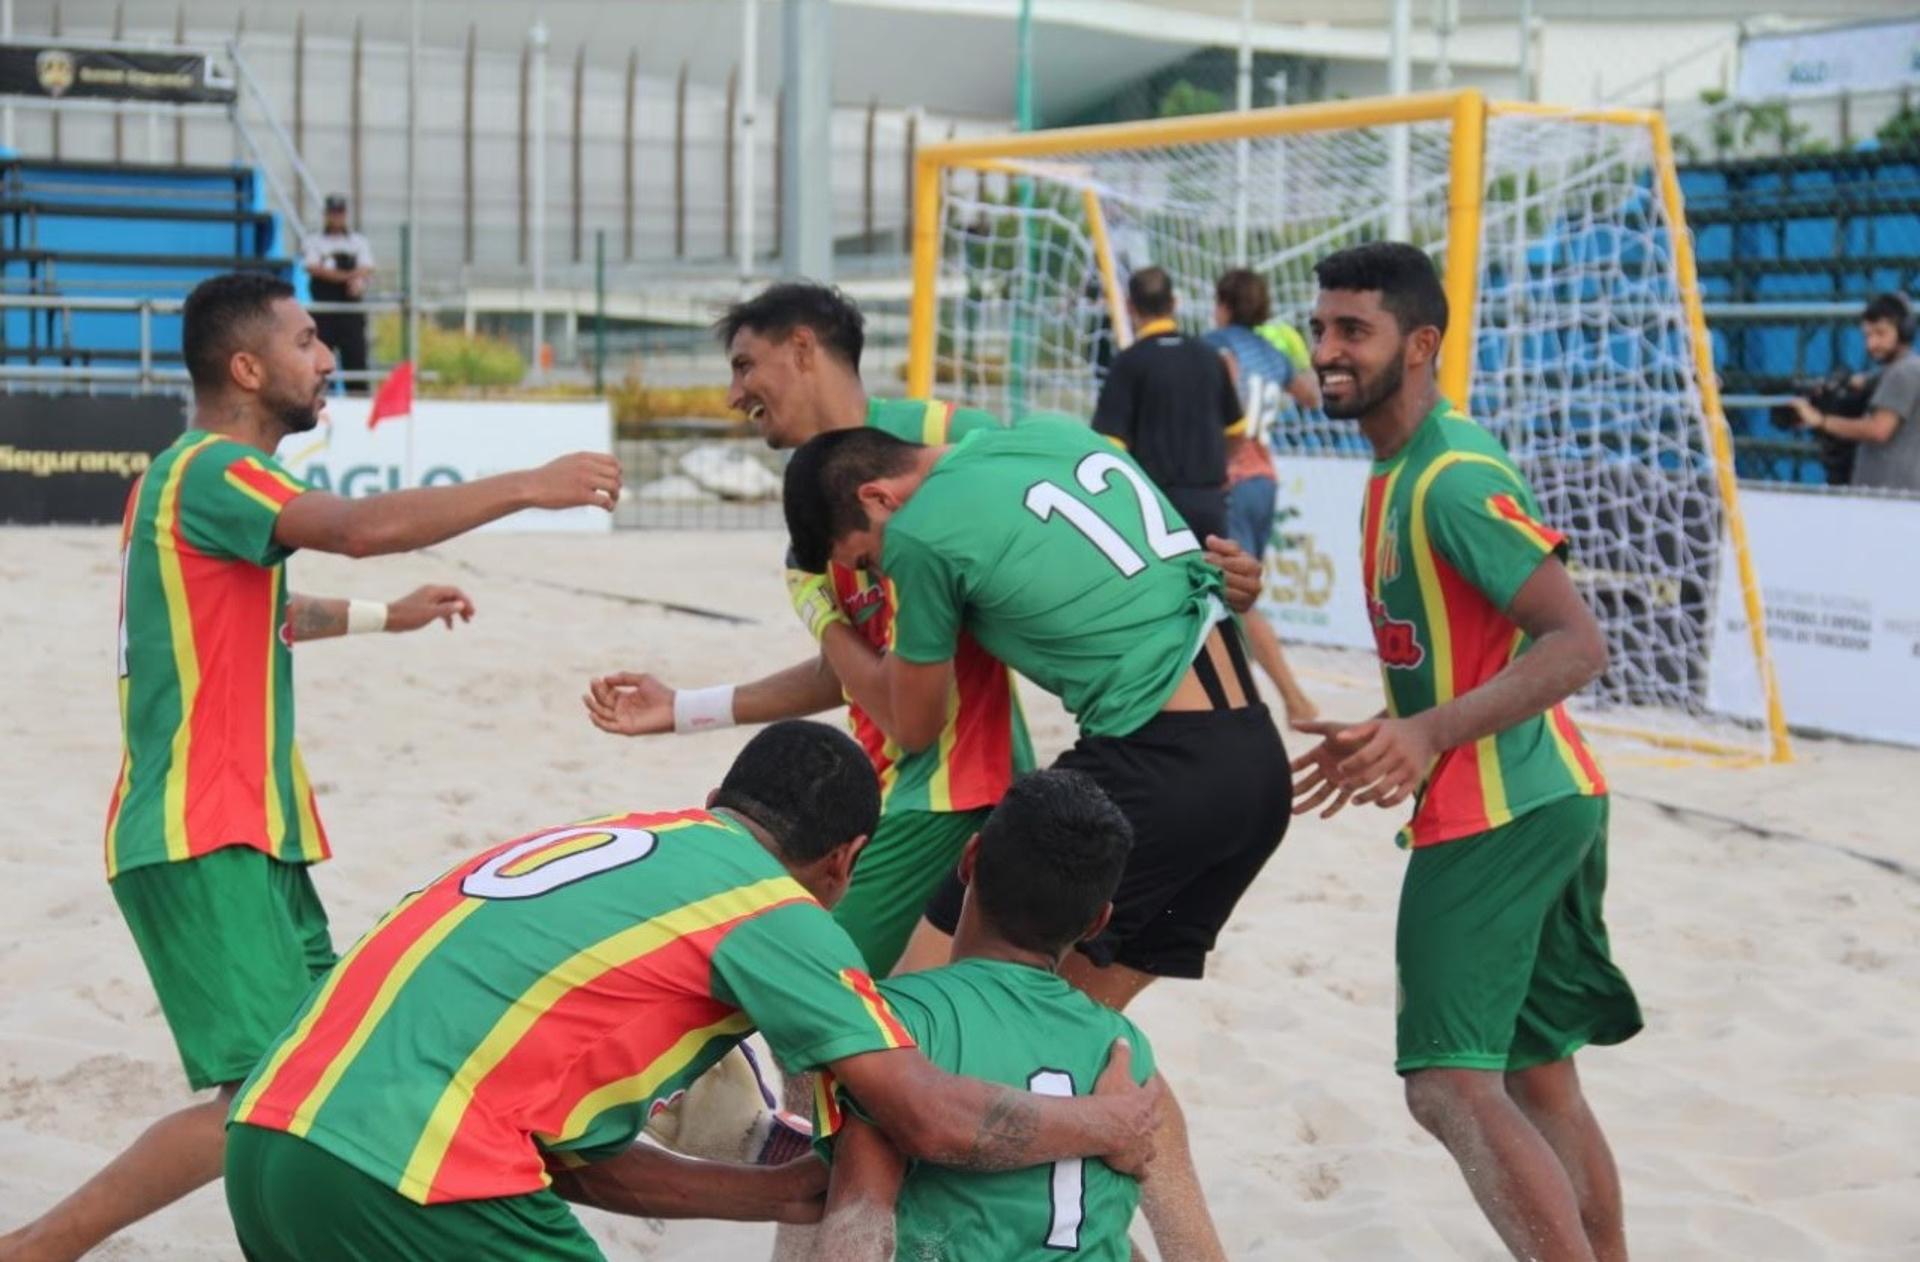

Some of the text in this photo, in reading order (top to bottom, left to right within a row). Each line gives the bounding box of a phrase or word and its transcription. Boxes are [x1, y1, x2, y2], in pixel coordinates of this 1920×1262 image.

[0, 444, 149, 478] Segurança
[1023, 450, 1202, 579] 12
[459, 826, 659, 901] 0
[1026, 1066, 1086, 1252] 1
